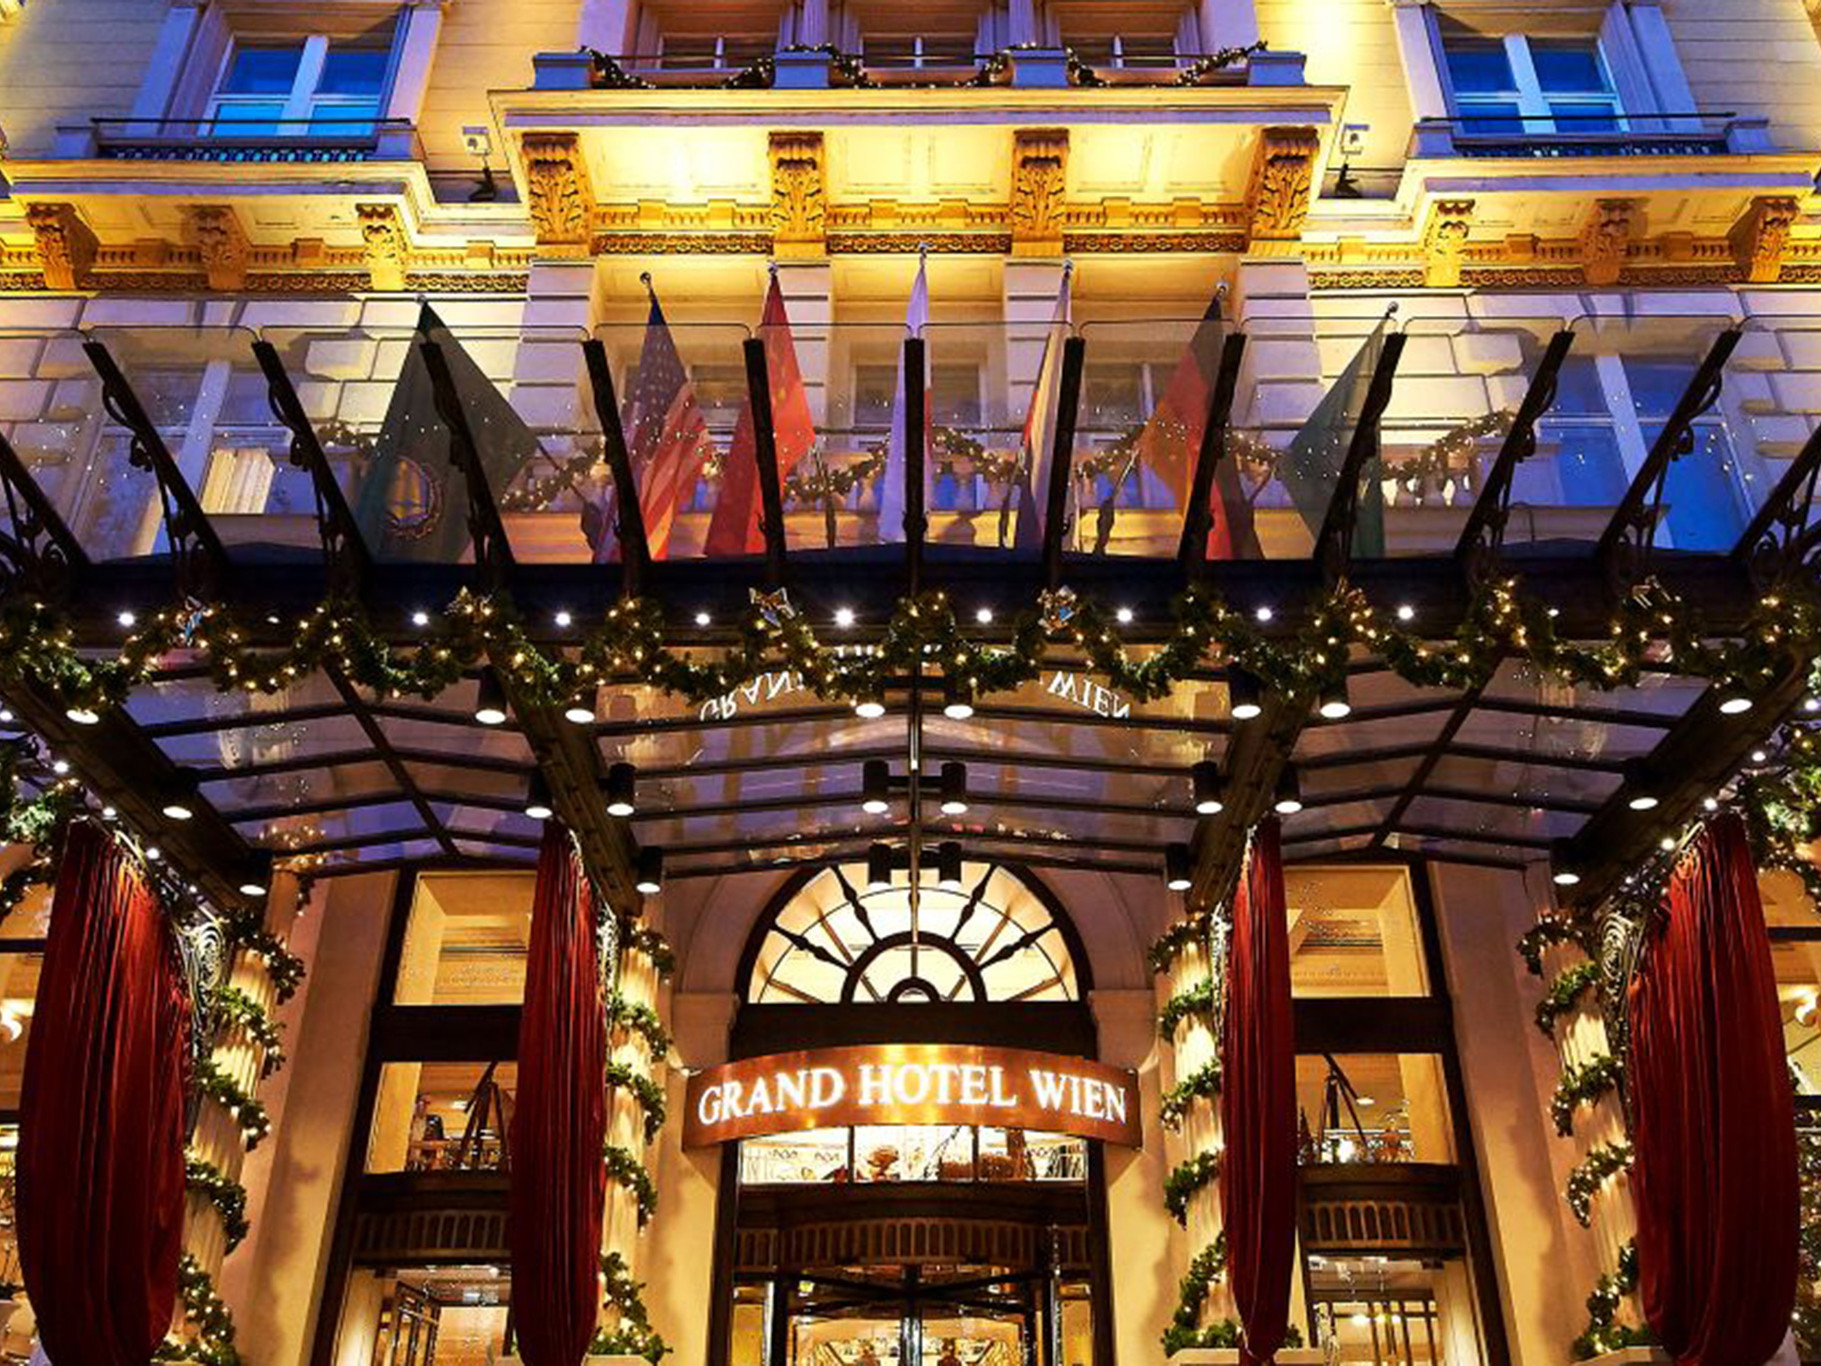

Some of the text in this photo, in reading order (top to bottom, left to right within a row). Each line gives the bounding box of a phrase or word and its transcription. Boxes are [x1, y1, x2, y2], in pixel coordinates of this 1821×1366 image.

[698, 1064, 1127, 1126] GRAND HOTEL WIEN
